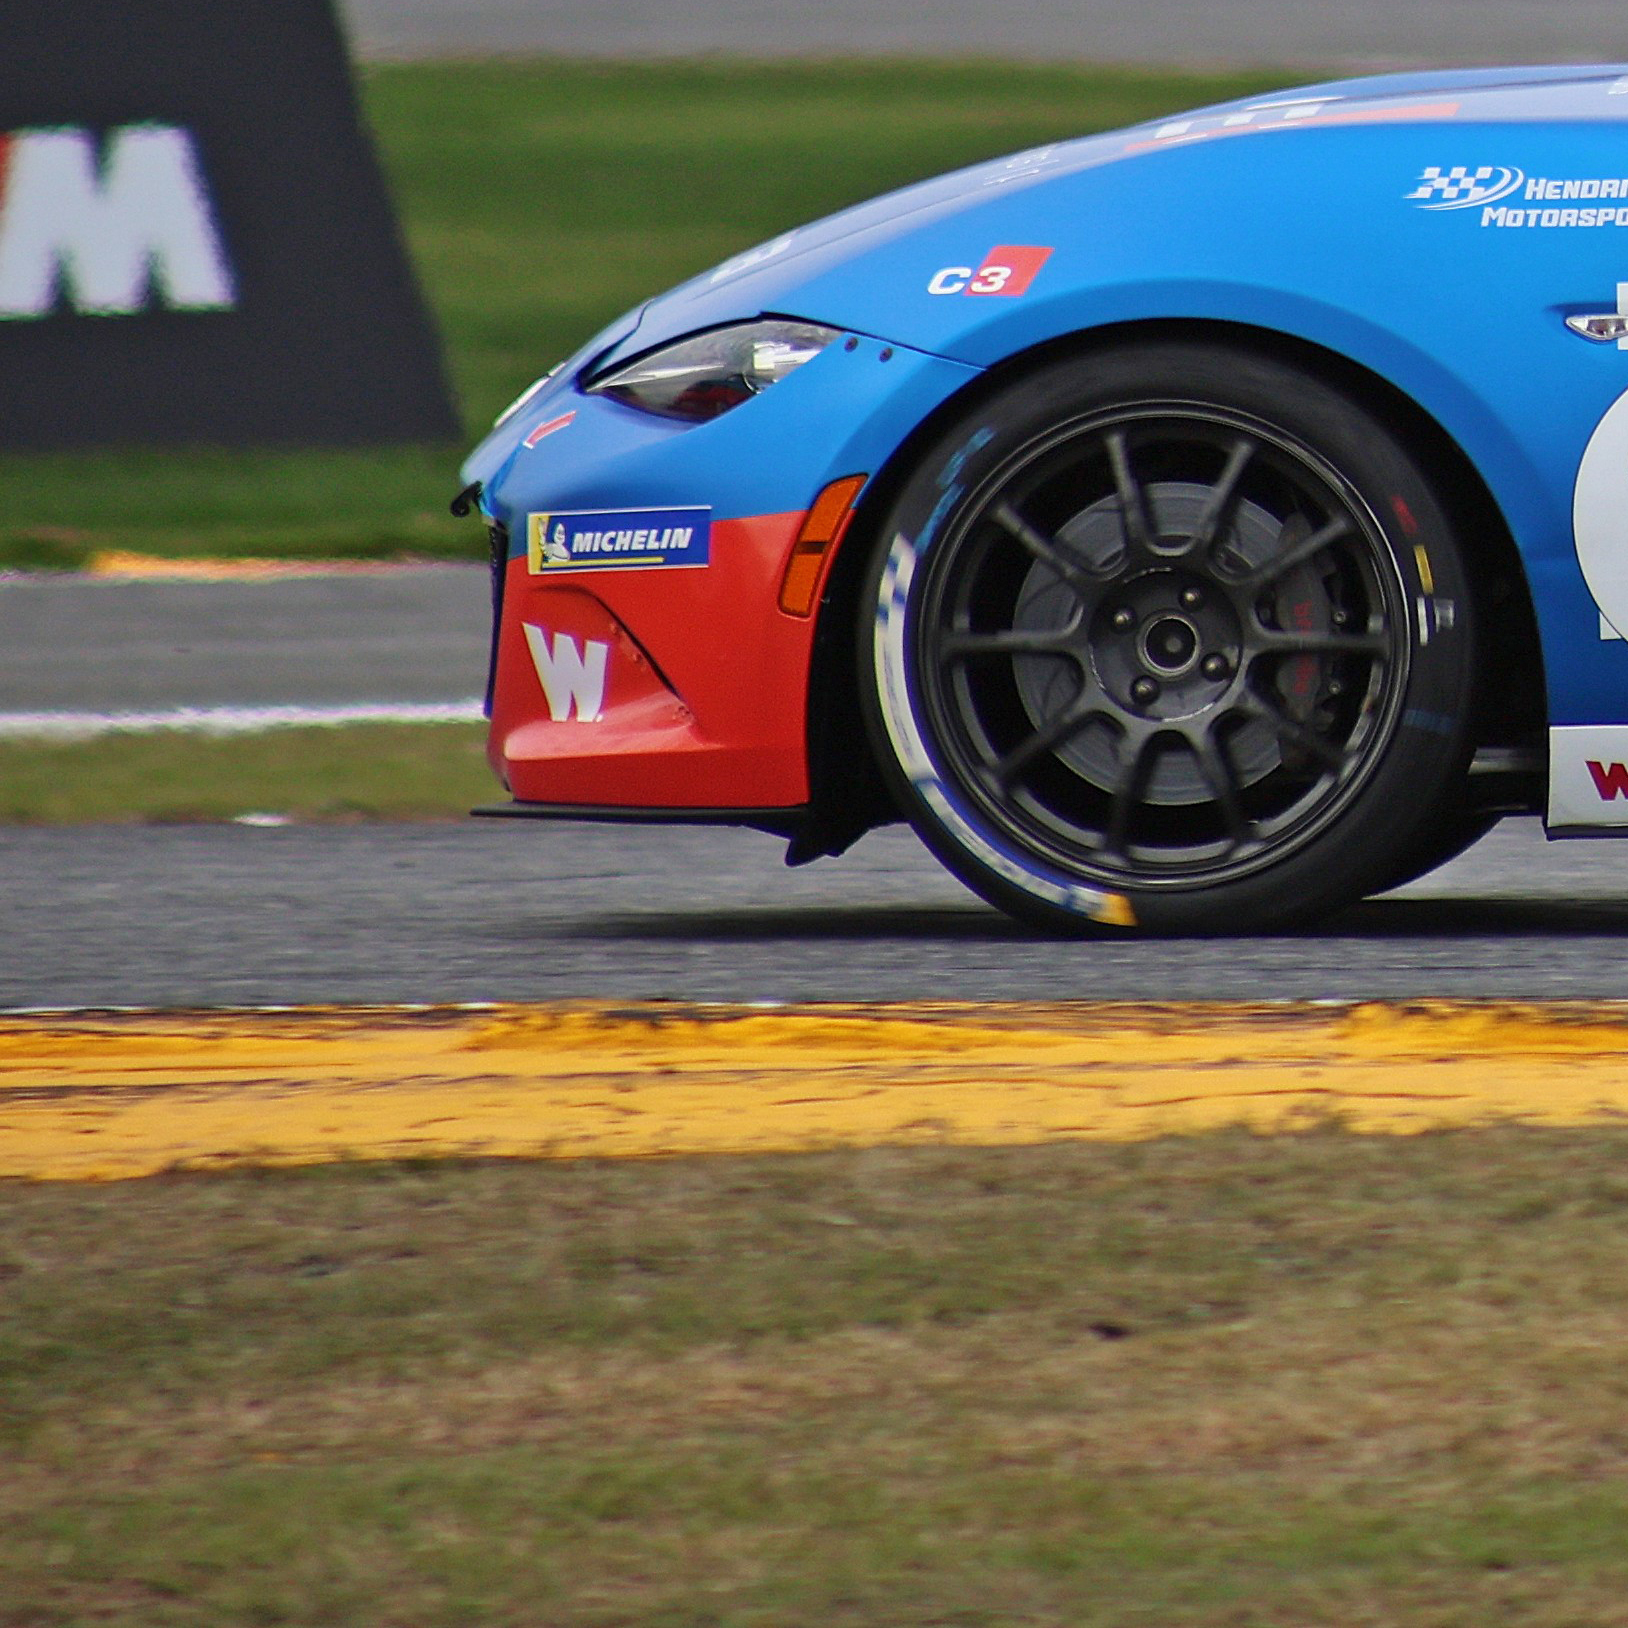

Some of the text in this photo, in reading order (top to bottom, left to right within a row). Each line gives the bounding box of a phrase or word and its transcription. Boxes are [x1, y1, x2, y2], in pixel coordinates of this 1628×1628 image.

[927, 265, 1012, 295] C3
[572, 527, 694, 553] MICHELIN
[522, 622, 609, 722] W
